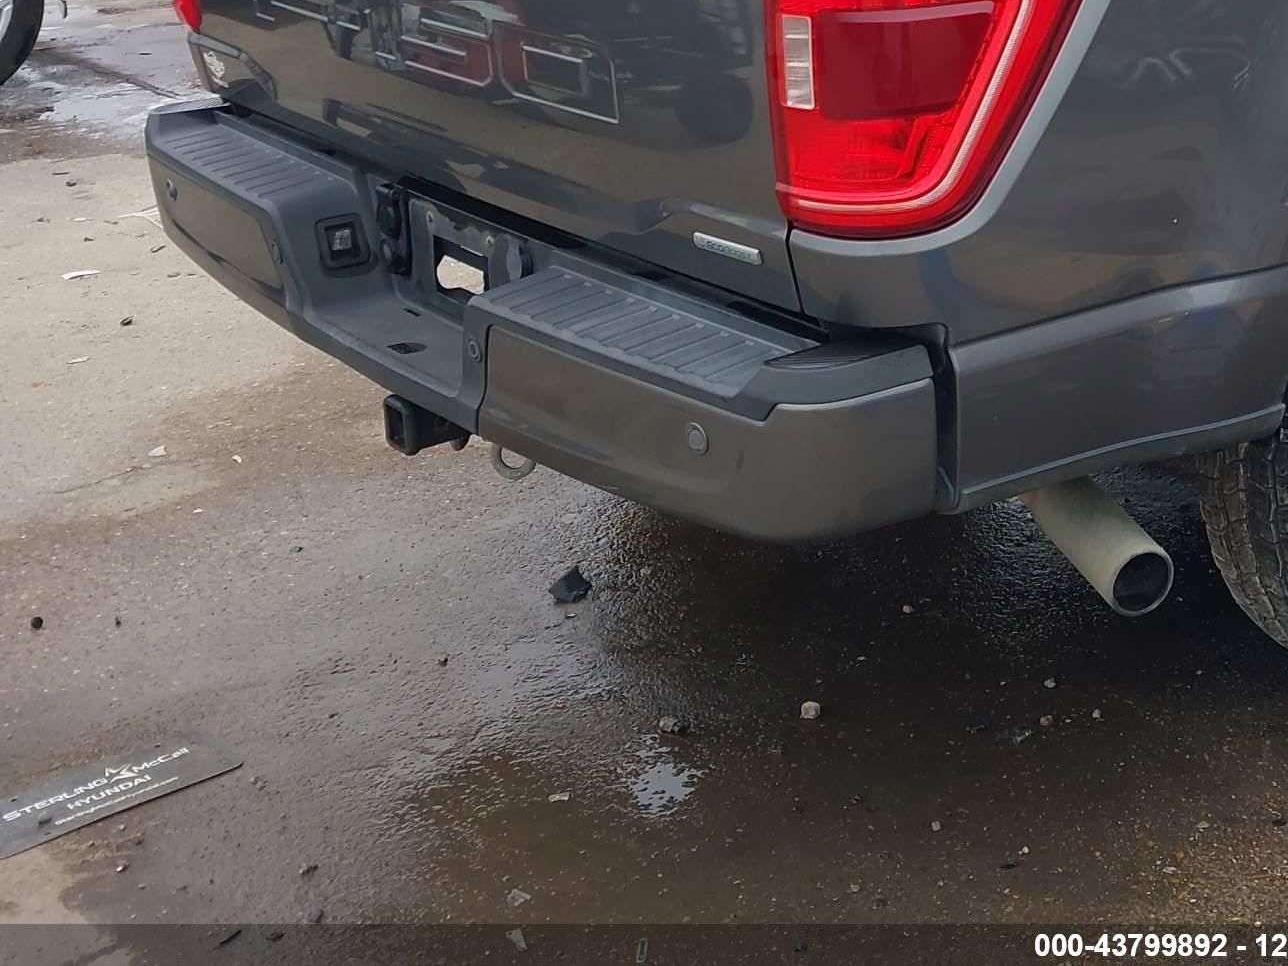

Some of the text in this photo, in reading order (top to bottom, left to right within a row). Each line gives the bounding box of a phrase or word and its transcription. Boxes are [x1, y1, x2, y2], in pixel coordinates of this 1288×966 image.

[2, 777, 108, 822] STERLING
[132, 747, 190, 773] McCall
[66, 774, 152, 810] HYUNDAI
